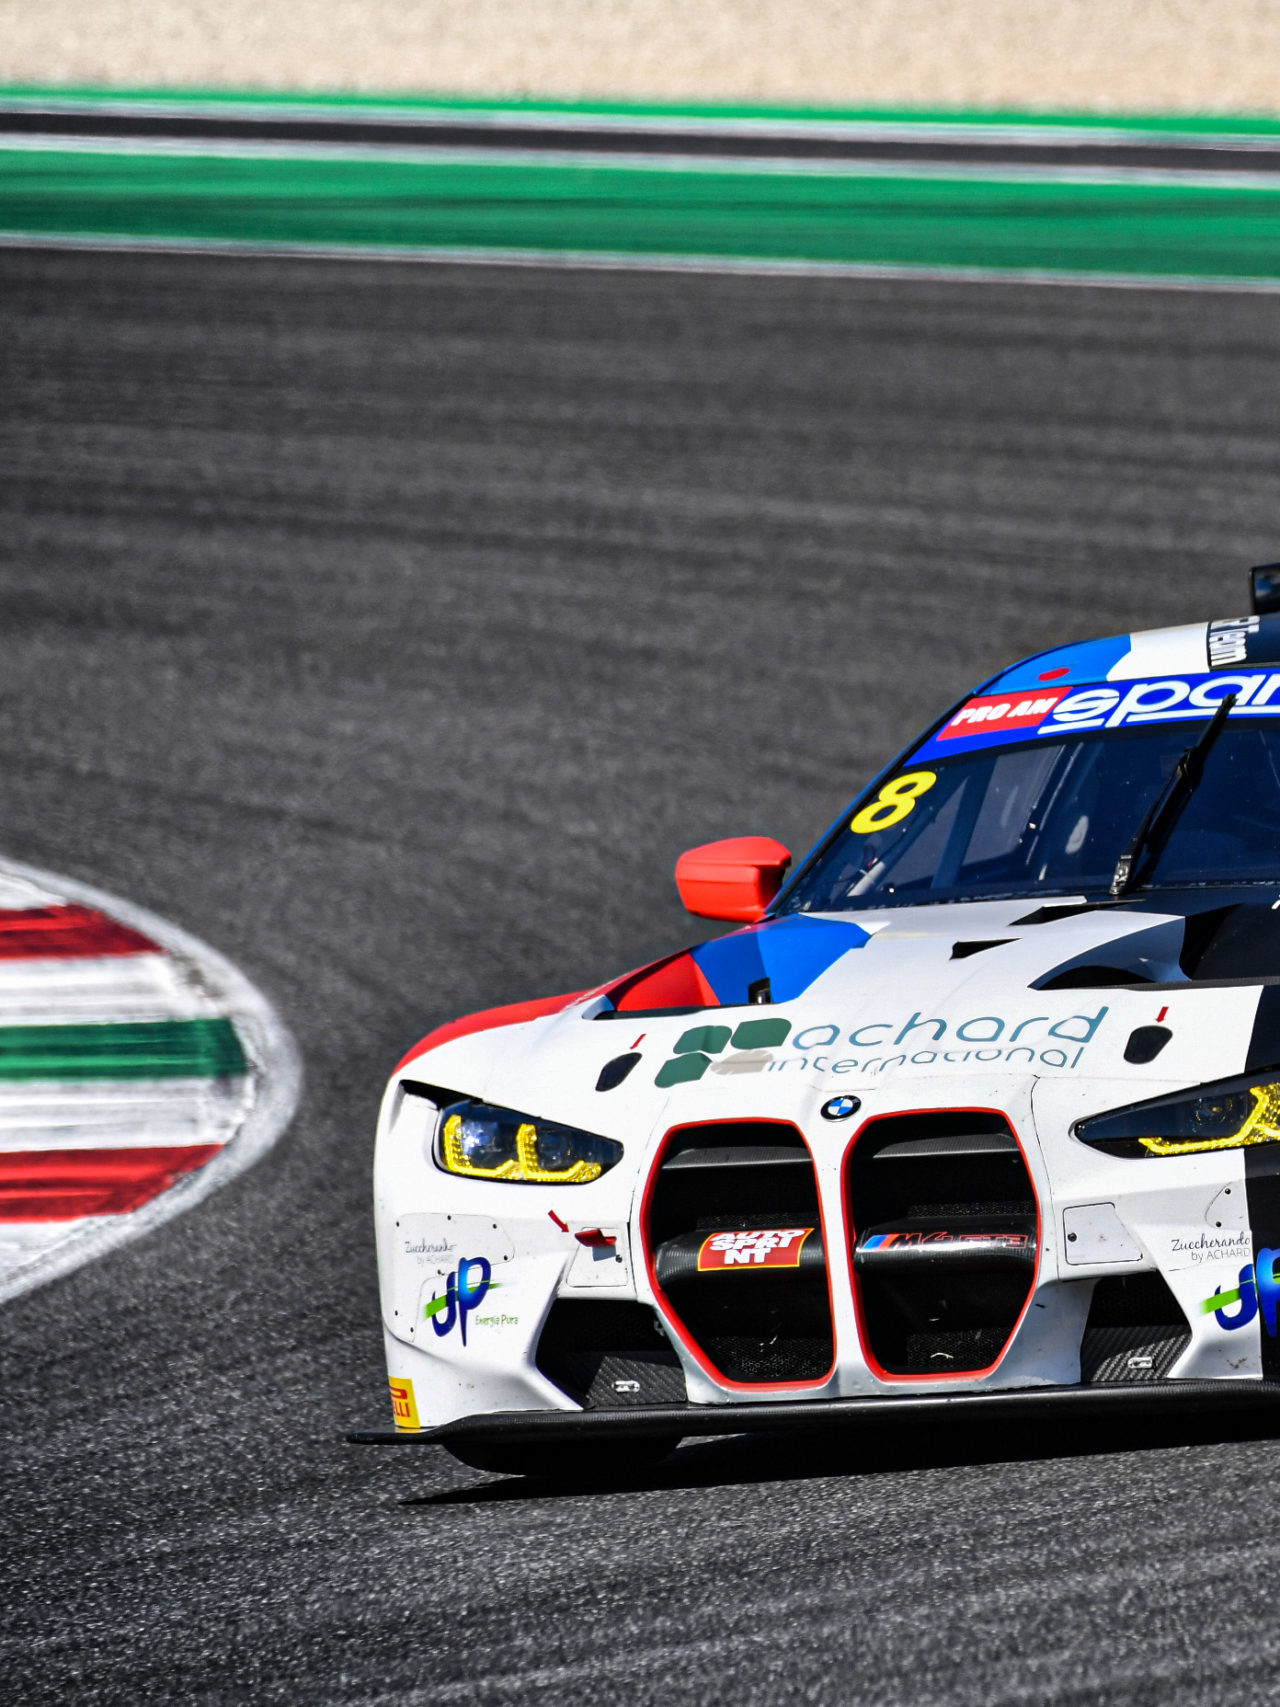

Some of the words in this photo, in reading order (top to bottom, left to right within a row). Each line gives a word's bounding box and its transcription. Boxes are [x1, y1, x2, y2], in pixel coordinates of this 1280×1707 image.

[950, 703, 1011, 726] PRO
[1007, 697, 1059, 718] AM
[850, 770, 937, 834] 8
[791, 1005, 1110, 1050] achard
[767, 1046, 1085, 1074] international
[709, 1237, 793, 1251] SPRI
[710, 1230, 806, 1241] AUTO
[1170, 1231, 1251, 1252] Zuccherando
[724, 1247, 772, 1265] NT
[1191, 1250, 1203, 1263] by
[1206, 1247, 1251, 1259] ACHARD
